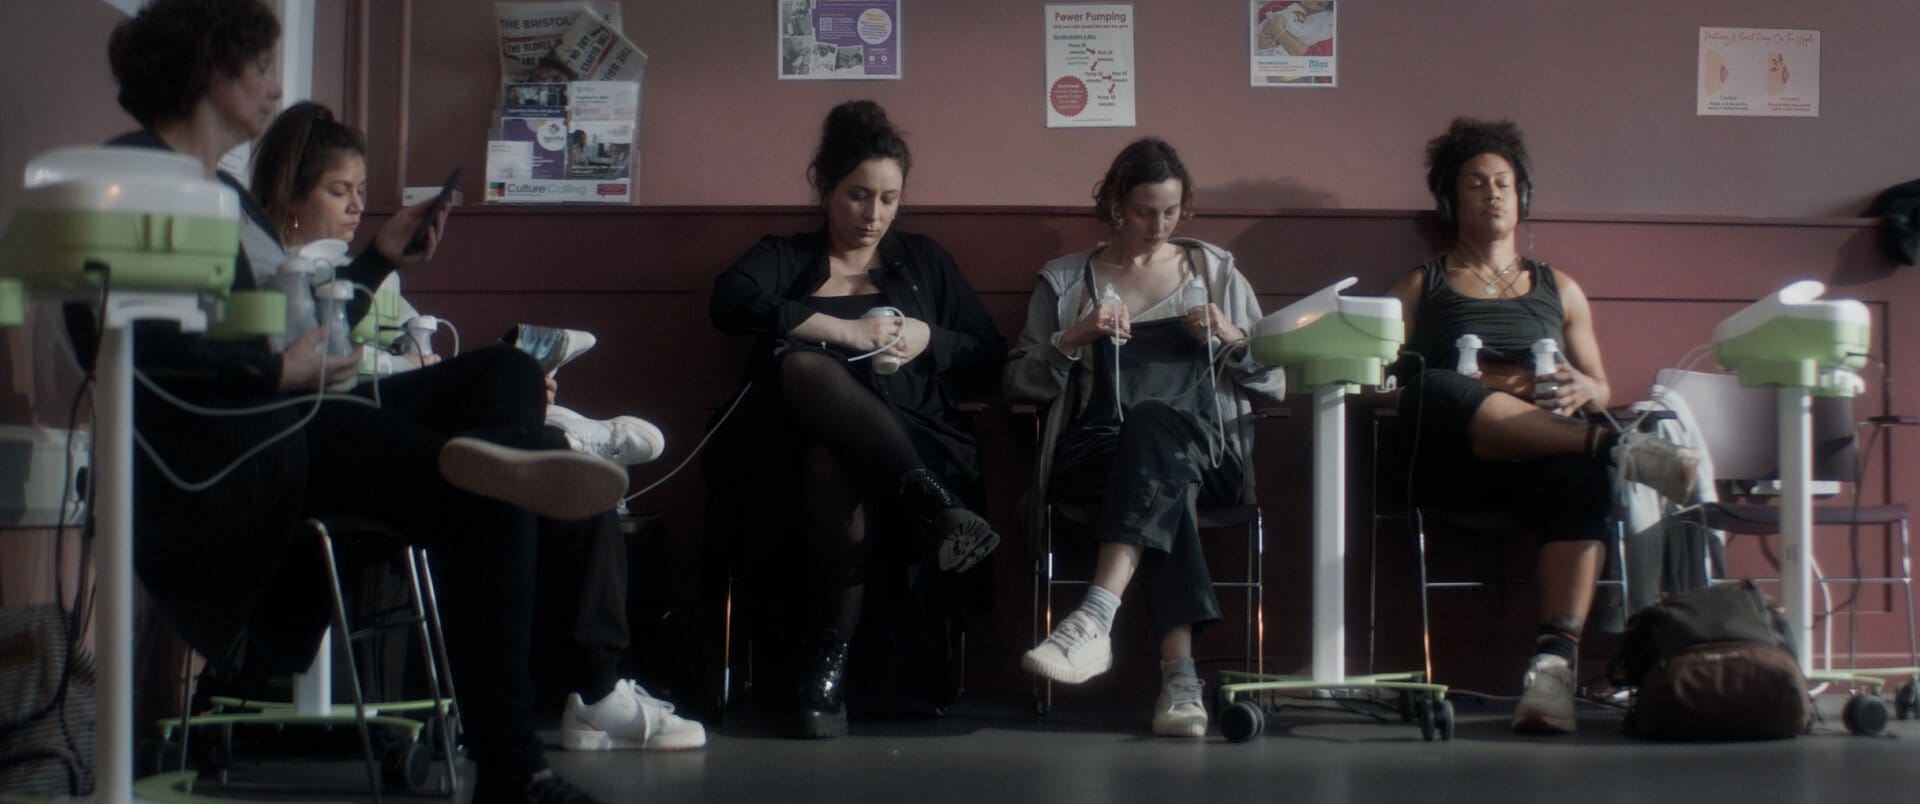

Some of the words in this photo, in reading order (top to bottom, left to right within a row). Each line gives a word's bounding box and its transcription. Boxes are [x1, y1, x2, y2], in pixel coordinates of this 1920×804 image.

[501, 19, 519, 30] THE
[522, 17, 571, 29] BRISTOL
[1055, 12, 1083, 22] Power
[1085, 11, 1127, 23] Pumping
[577, 35, 591, 50] ARE
[596, 30, 610, 48] THE
[506, 43, 521, 53] THE
[522, 40, 551, 51] GLOVES
[580, 46, 603, 73] GLOVES
[615, 46, 633, 65] THE
[1309, 59, 1328, 68] Bliss
[507, 183, 546, 194] Culture
